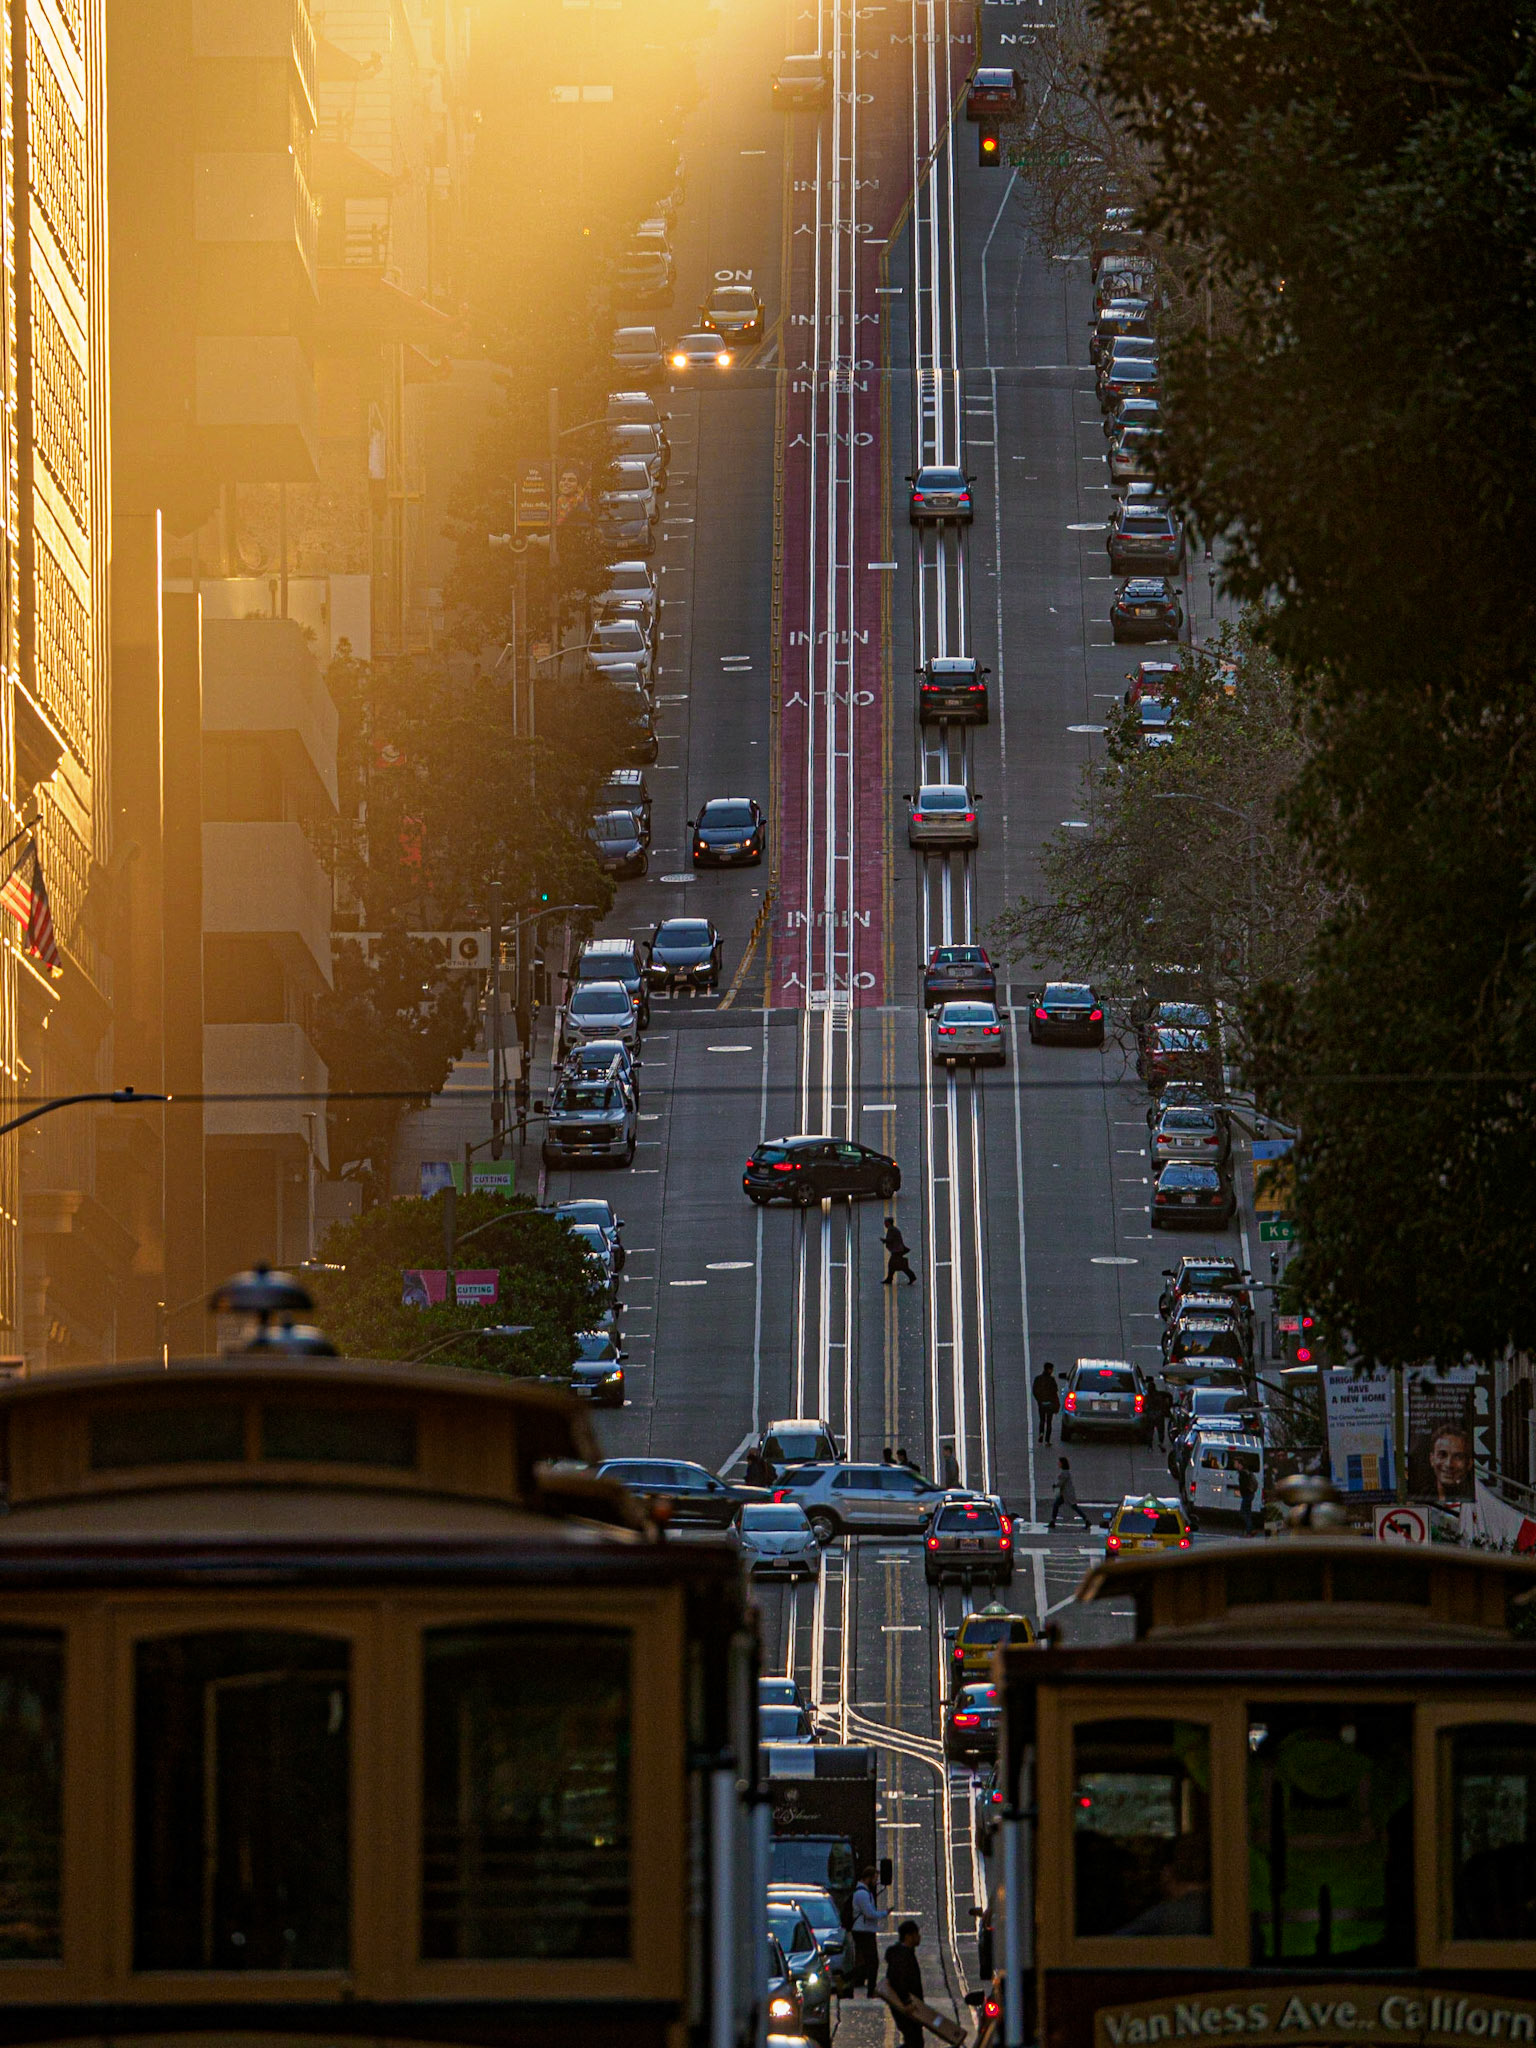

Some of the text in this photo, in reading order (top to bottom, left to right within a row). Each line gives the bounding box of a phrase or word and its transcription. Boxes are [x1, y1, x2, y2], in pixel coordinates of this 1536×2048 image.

[889, 34, 973, 44] MUNI
[1000, 34, 1037, 45] NO
[794, 223, 874, 234] ONLY
[714, 270, 753, 281] NO
[789, 432, 874, 447] ONLY
[788, 630, 869, 646] MUNI
[785, 691, 876, 708] ONLY
[787, 911, 871, 928] MUNI
[782, 971, 876, 989] ONLY
[457, 1286, 492, 1294] CUTTING
[1347, 1385, 1369, 1393] HAVE
[1332, 1393, 1386, 1404] A NEW HOME
